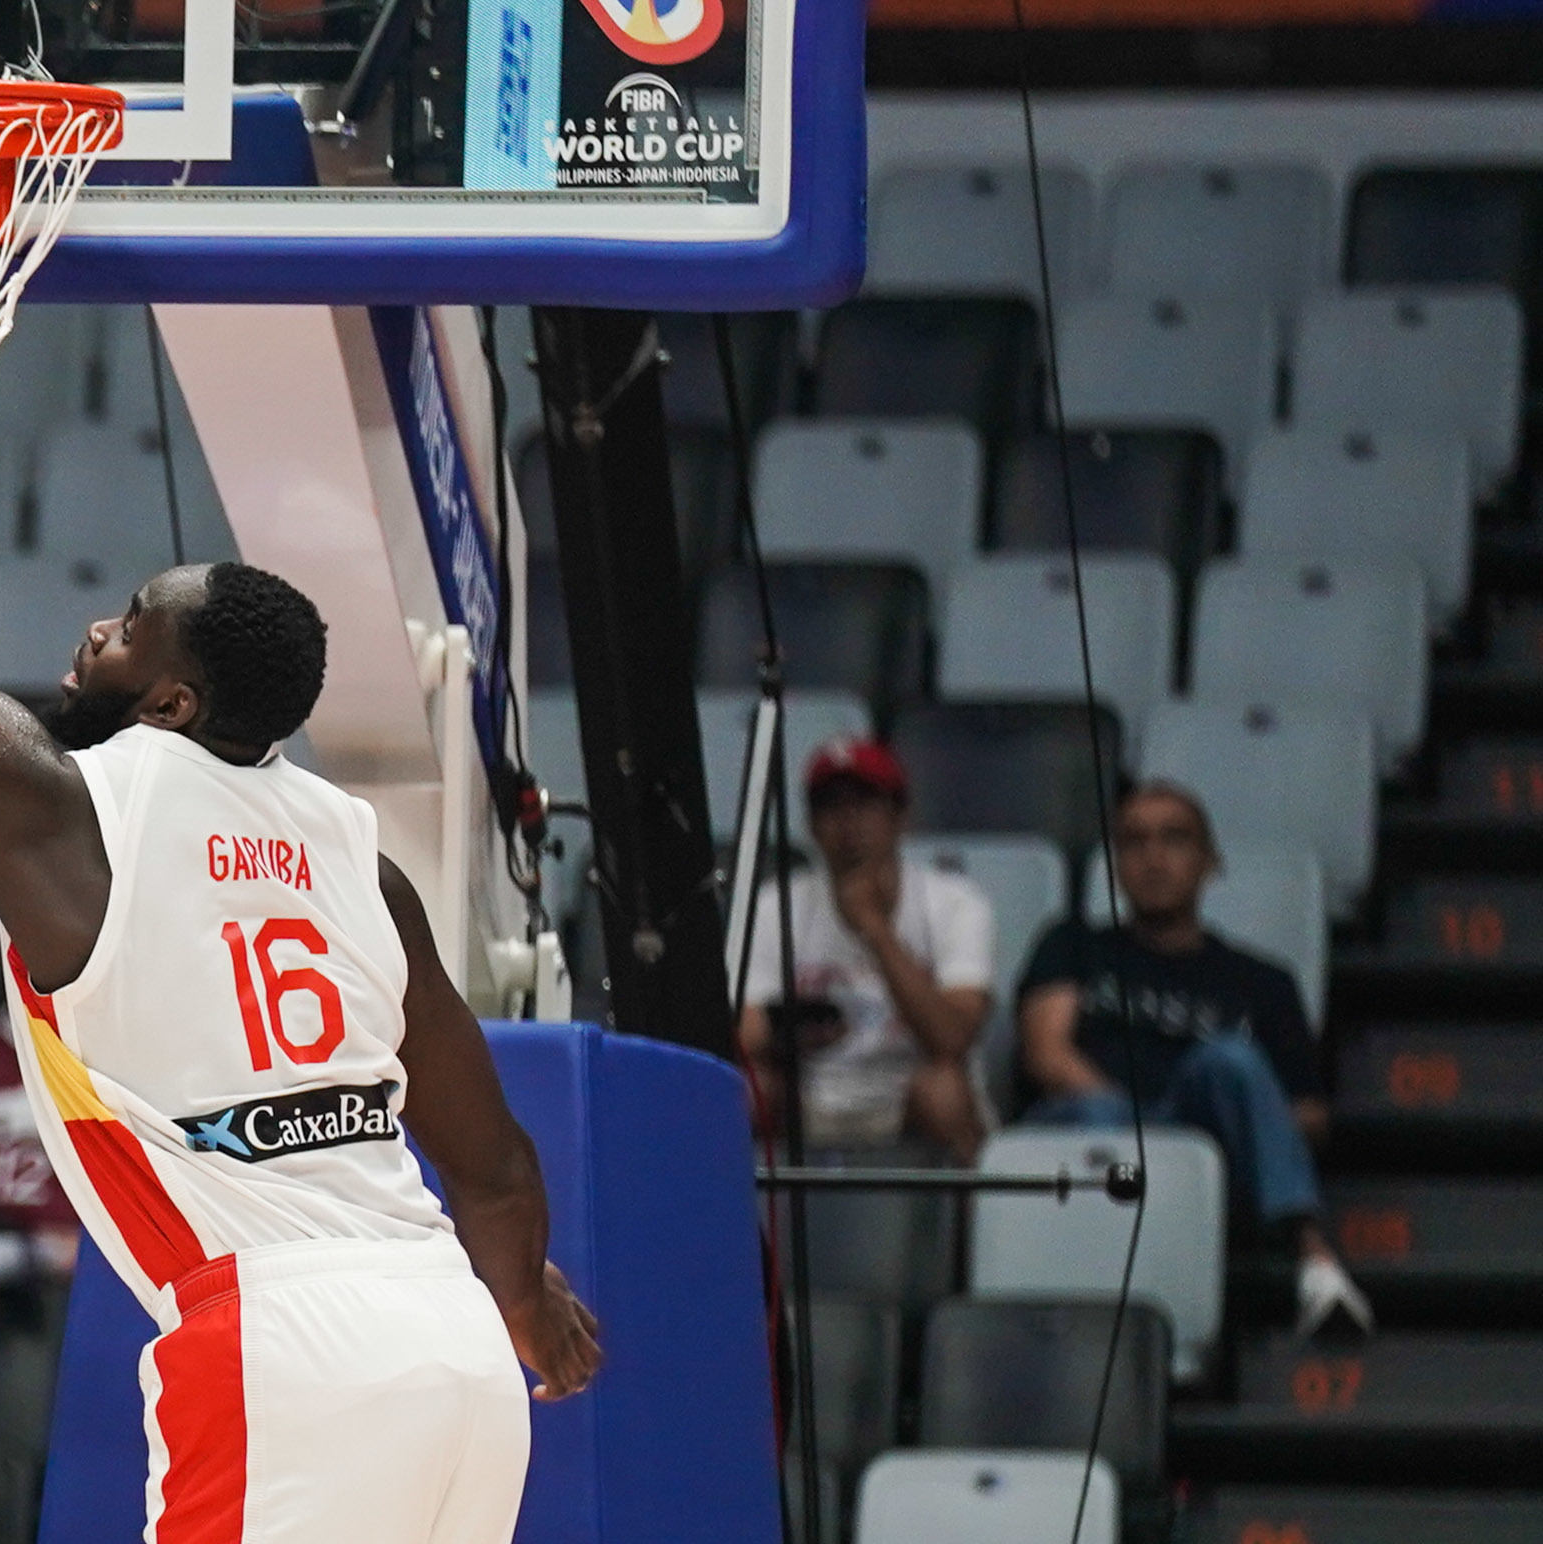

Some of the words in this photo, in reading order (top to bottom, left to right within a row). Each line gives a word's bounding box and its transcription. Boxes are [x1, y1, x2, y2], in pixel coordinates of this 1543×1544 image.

[620, 88, 666, 113] FIBA
[543, 133, 668, 163] WORLD
[674, 132, 744, 163] CUP
[207, 833, 313, 892] GARUBA
[220, 917, 346, 1073] 16
[1290, 1358, 1365, 1415] 07
